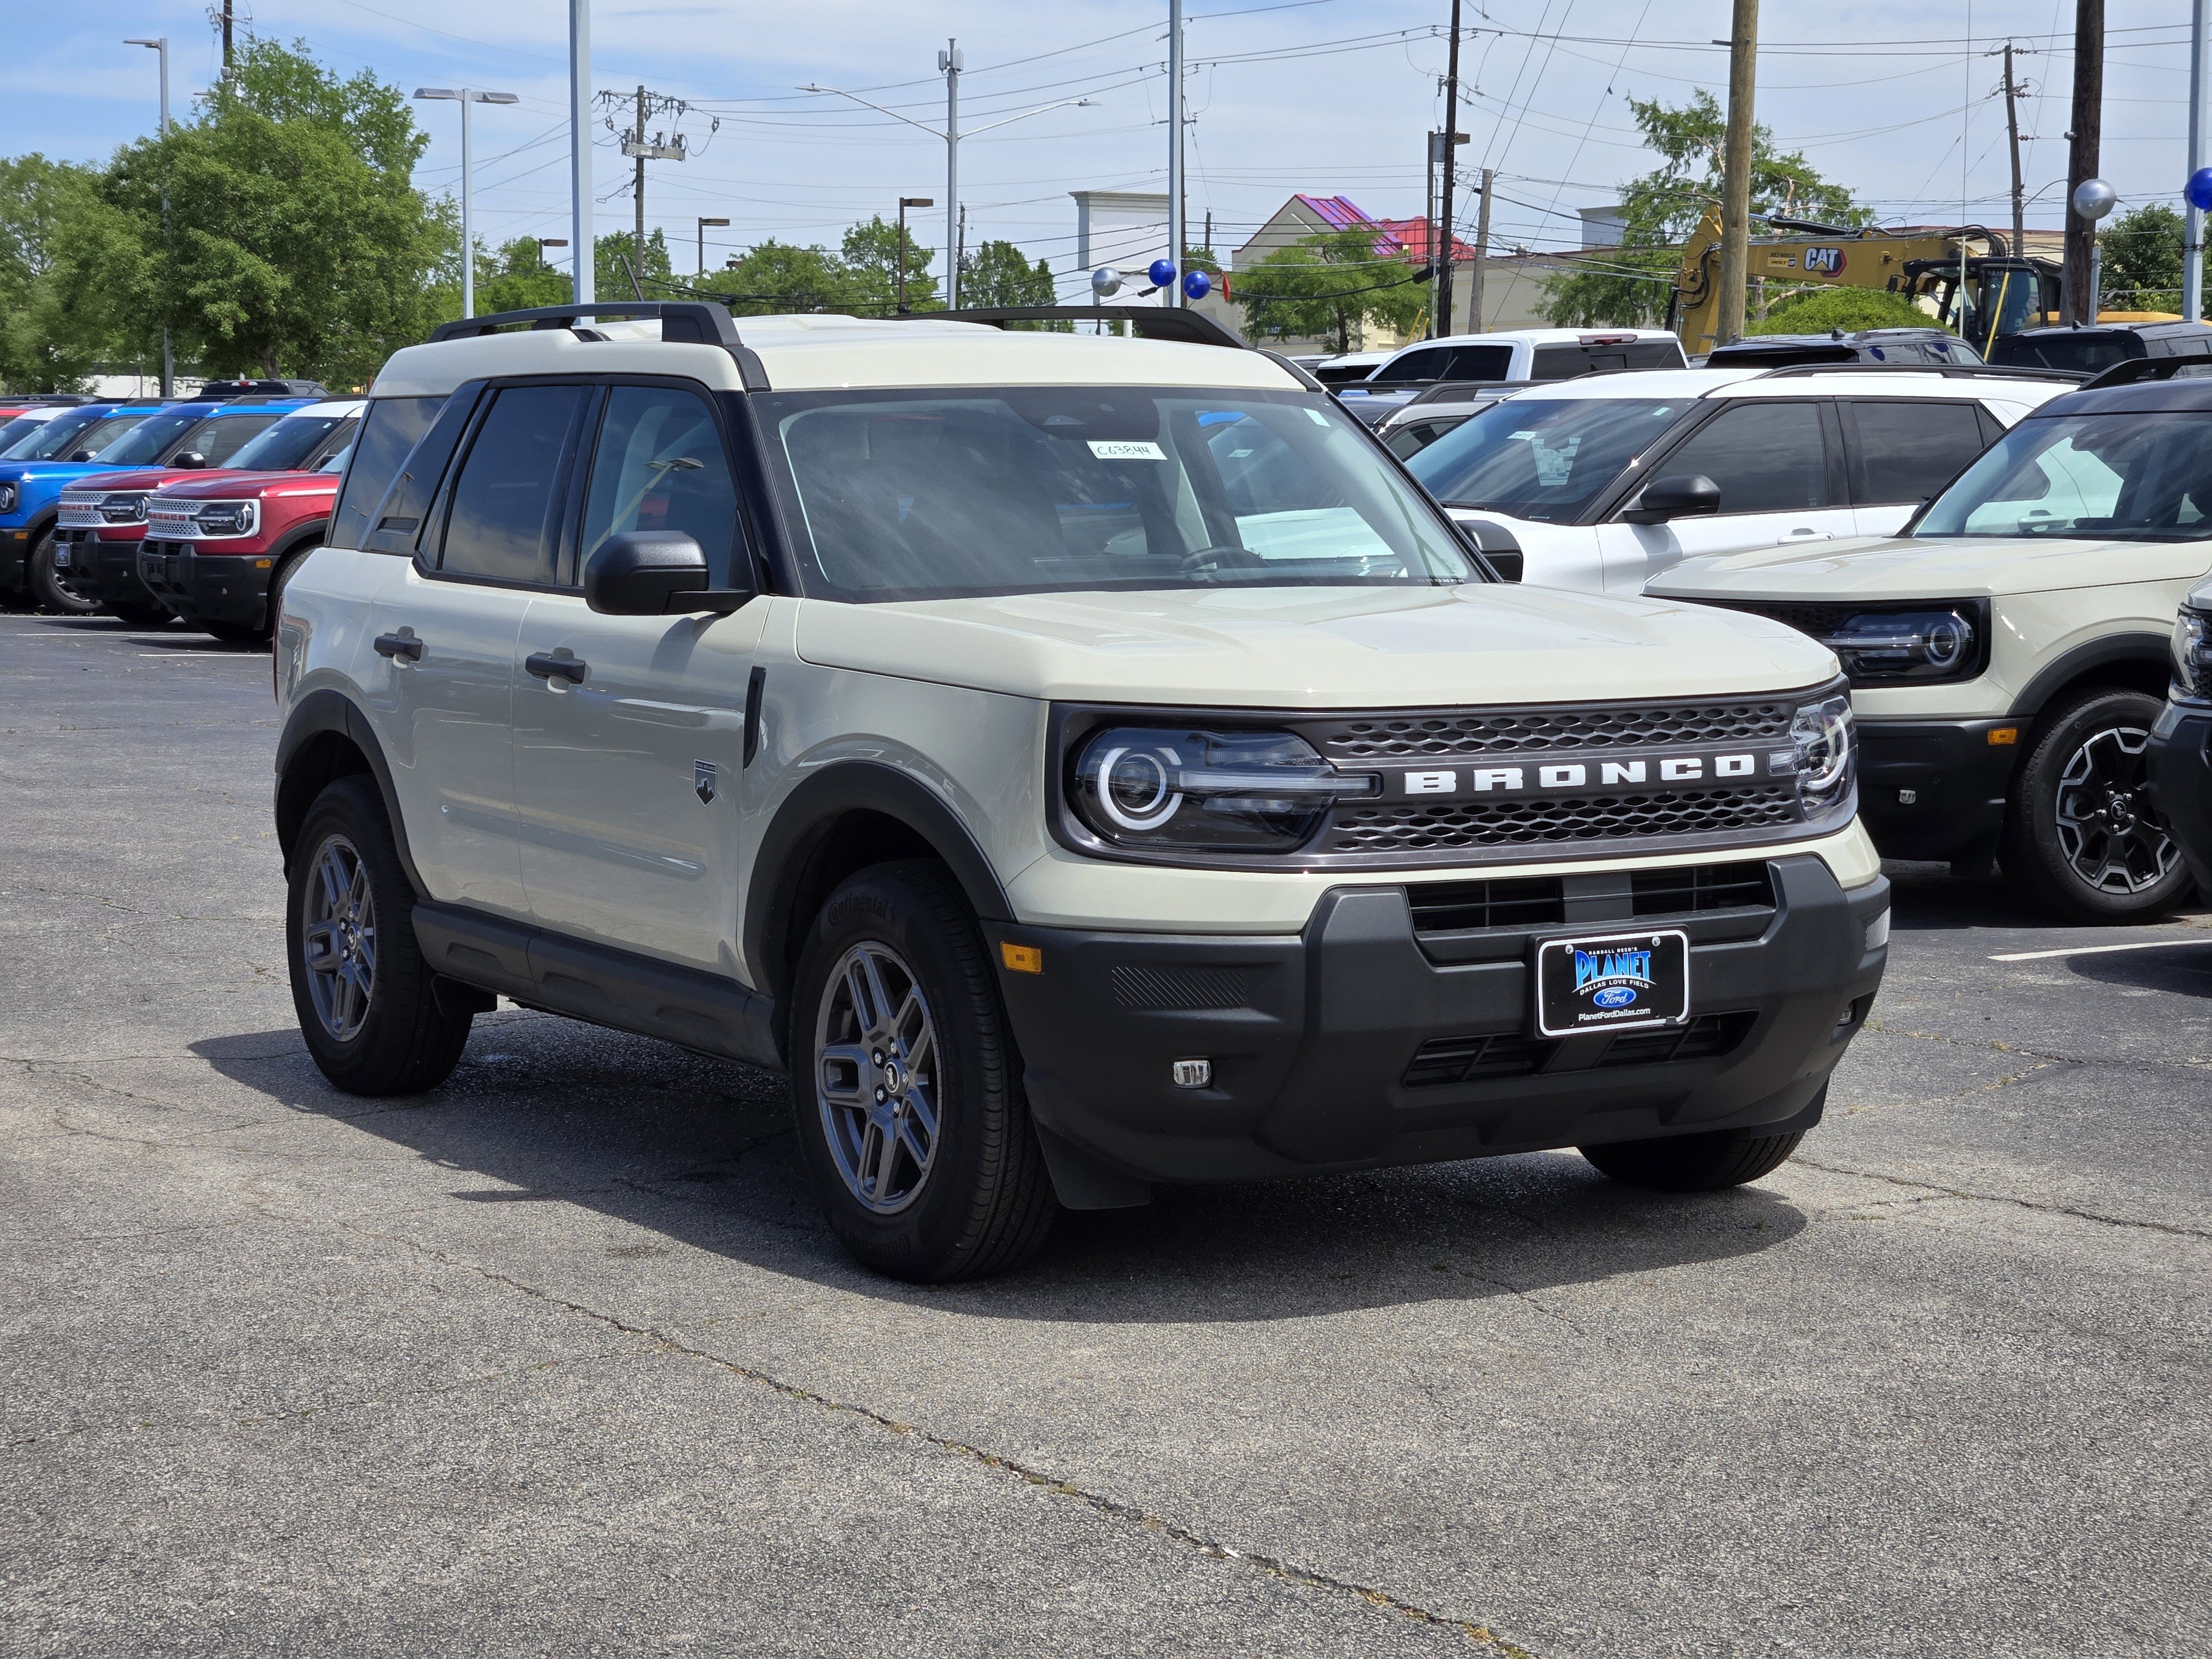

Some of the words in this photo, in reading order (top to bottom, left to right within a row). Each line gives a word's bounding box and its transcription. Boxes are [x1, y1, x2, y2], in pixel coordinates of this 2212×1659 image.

[1804, 248, 1838, 271] CAT
[1097, 445, 1151, 456] C63844
[1404, 754, 1755, 795] BRONCO
[827, 891, 888, 927] Continental
[1575, 950, 1651, 989] PLANET
[1579, 982, 1606, 995] DALLAS
[1629, 980, 1649, 989] FIELD
[1601, 989, 1628, 1005] Ford
[1578, 1008, 1651, 1021] PlanetFordDallas.com
